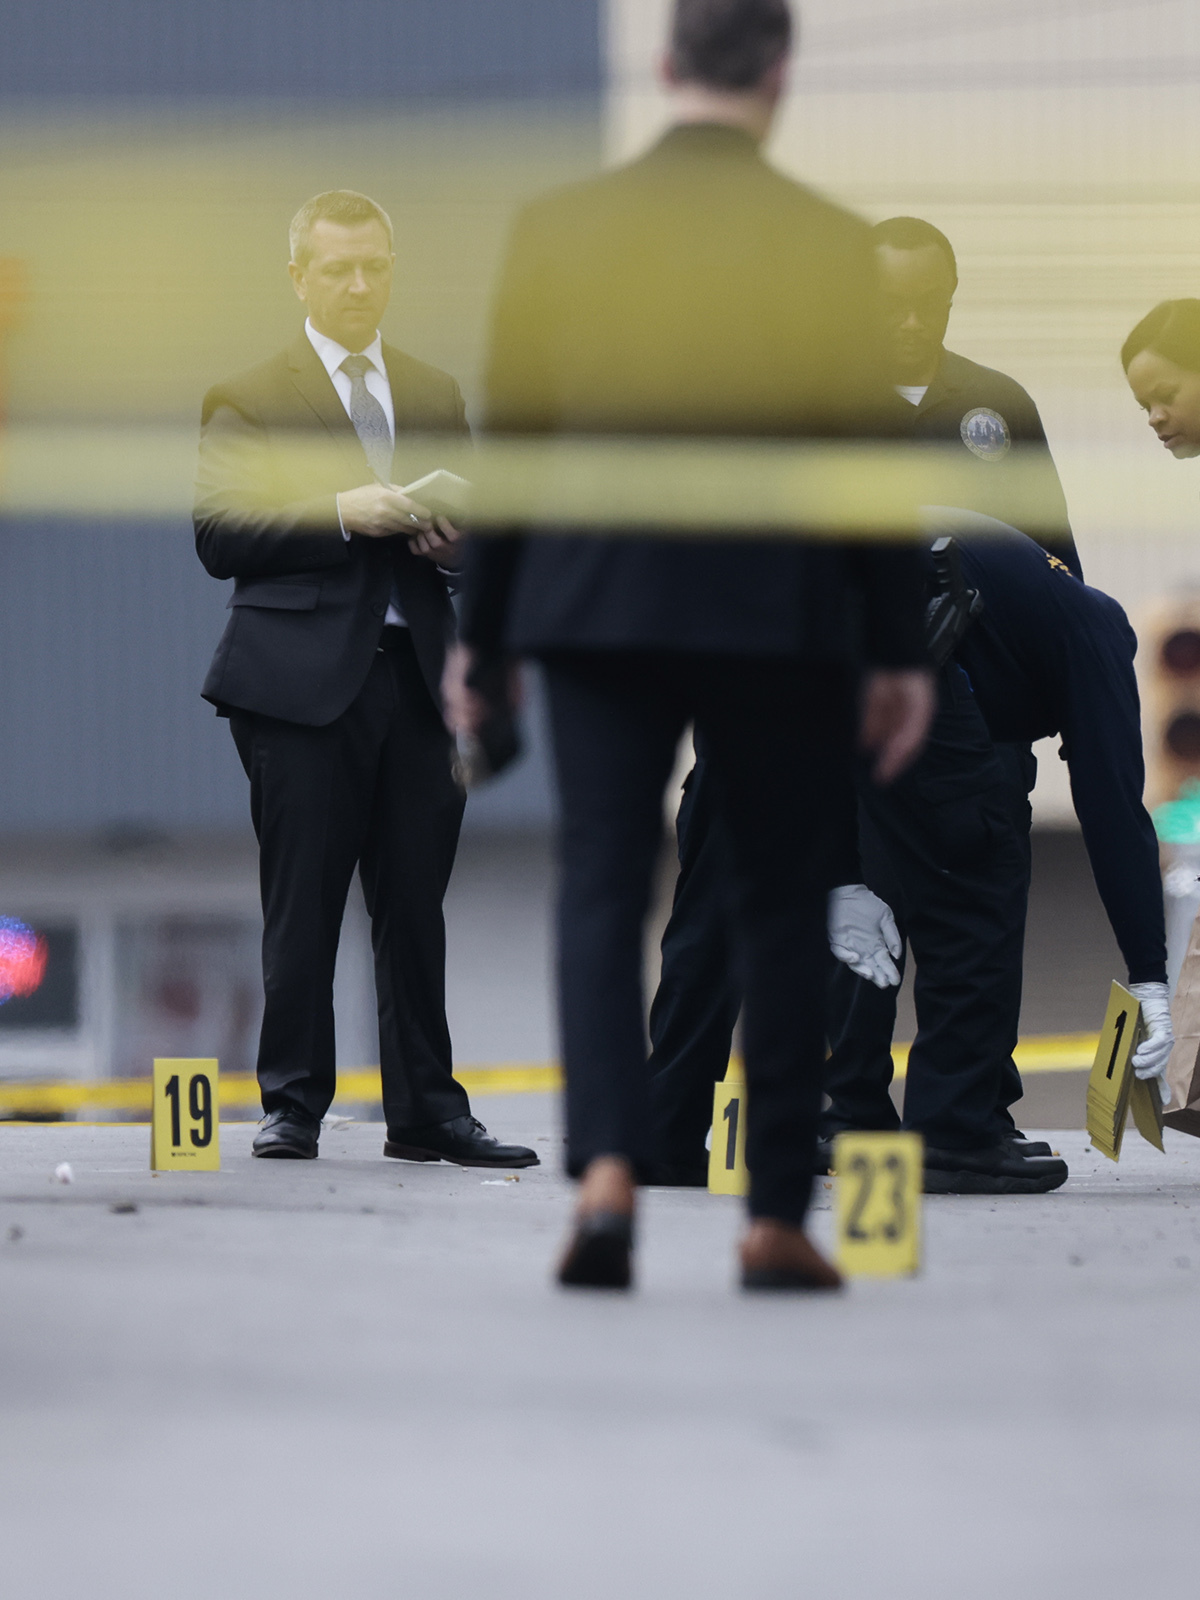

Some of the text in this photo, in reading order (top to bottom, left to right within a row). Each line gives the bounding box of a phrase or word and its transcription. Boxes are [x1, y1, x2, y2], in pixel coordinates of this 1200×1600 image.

[1106, 1010, 1127, 1080] 1
[165, 1073, 212, 1148] 19
[847, 1152, 908, 1244] 23
